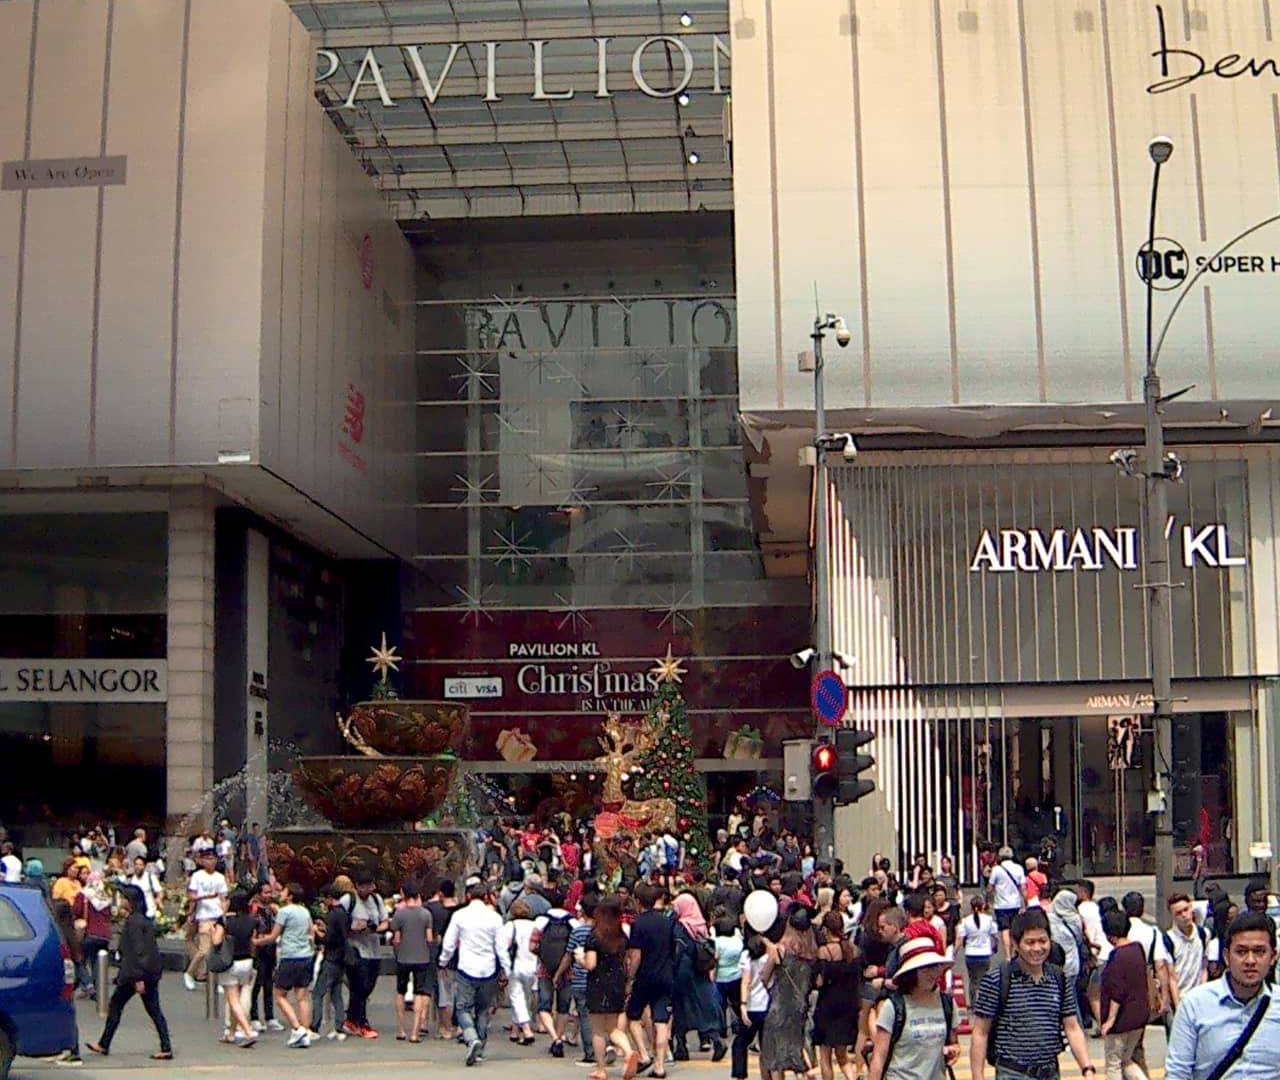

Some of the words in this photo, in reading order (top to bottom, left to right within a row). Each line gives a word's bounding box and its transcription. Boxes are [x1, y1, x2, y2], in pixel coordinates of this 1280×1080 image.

[1138, 249, 1186, 281] DC
[1195, 256, 1265, 273] SUPER
[464, 300, 732, 349] PAVILIO
[970, 527, 1137, 571] ARMANI
[509, 642, 579, 657] PAVILION
[581, 642, 601, 656] KL
[16, 668, 161, 693] SELANGOR
[475, 684, 498, 695] VISA
[517, 663, 659, 697] Christmas
[1086, 695, 1130, 709] ARMANI
